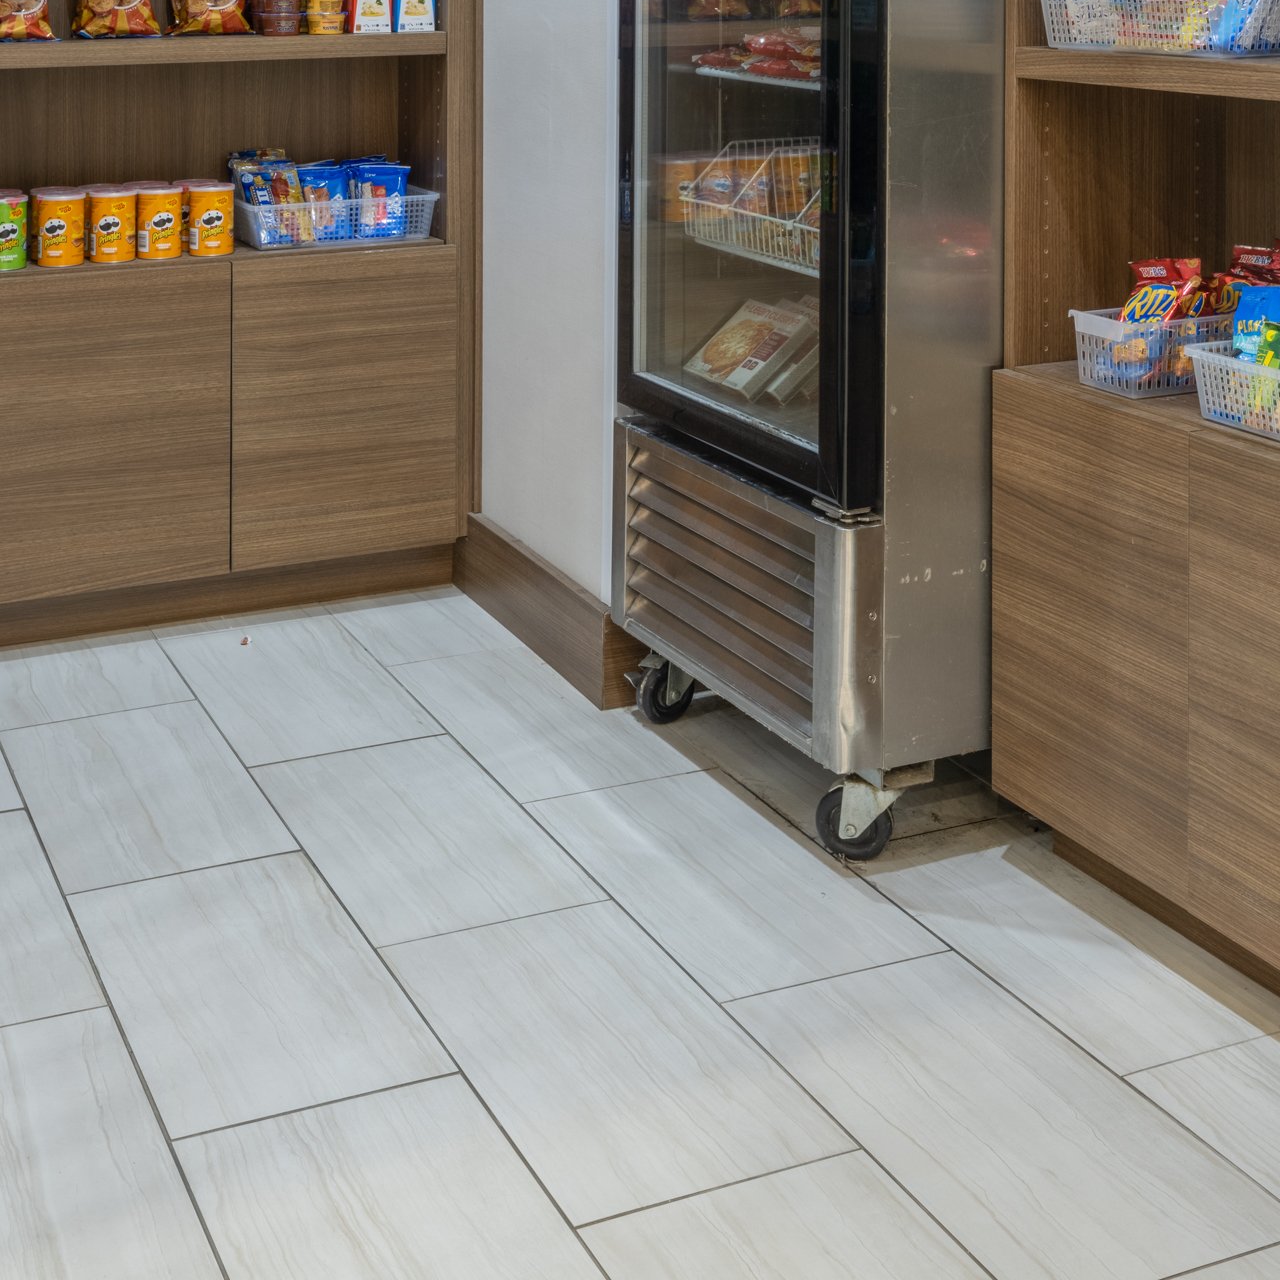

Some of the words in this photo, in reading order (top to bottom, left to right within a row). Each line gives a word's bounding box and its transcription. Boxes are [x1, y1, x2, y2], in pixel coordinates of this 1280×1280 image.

[99, 231, 121, 245] Pringles
[152, 228, 175, 241] Pringles
[201, 226, 224, 239] Pringles
[44, 235, 67, 248] Pringles
[1125, 285, 1178, 317] RITZ
